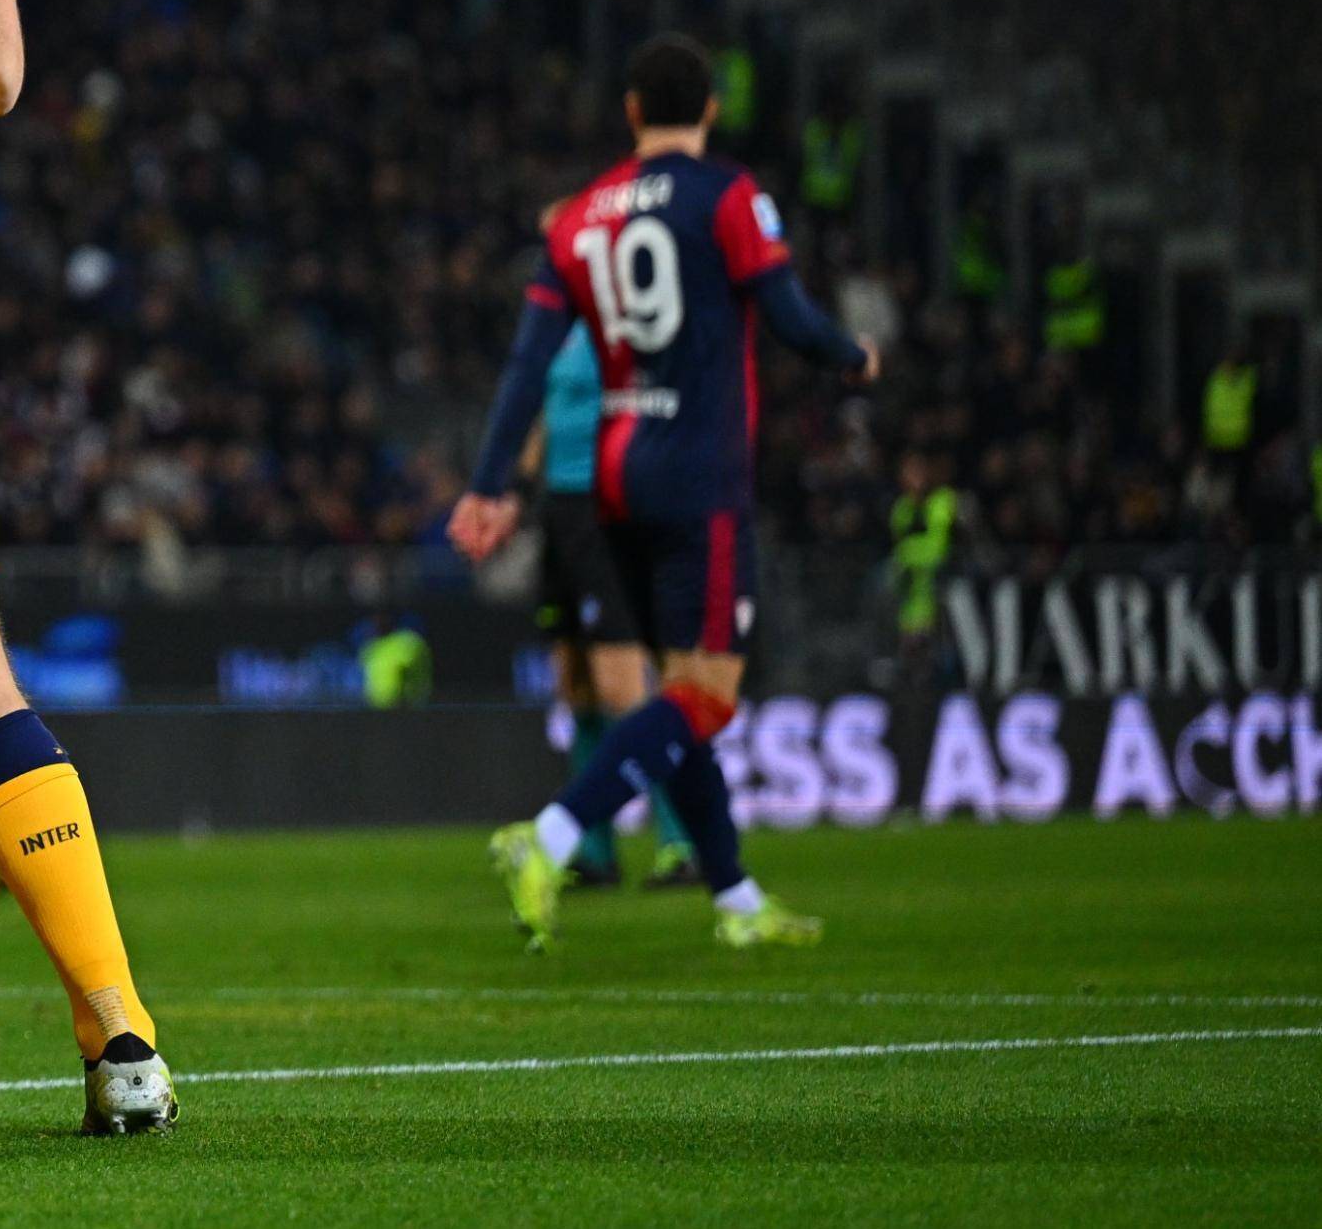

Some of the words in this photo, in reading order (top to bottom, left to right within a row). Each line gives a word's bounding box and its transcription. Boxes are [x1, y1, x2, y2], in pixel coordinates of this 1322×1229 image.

[572, 217, 683, 353] 19
[922, 691, 1070, 823] AS
[1094, 690, 1175, 820] A
[19, 822, 81, 857] INTER
